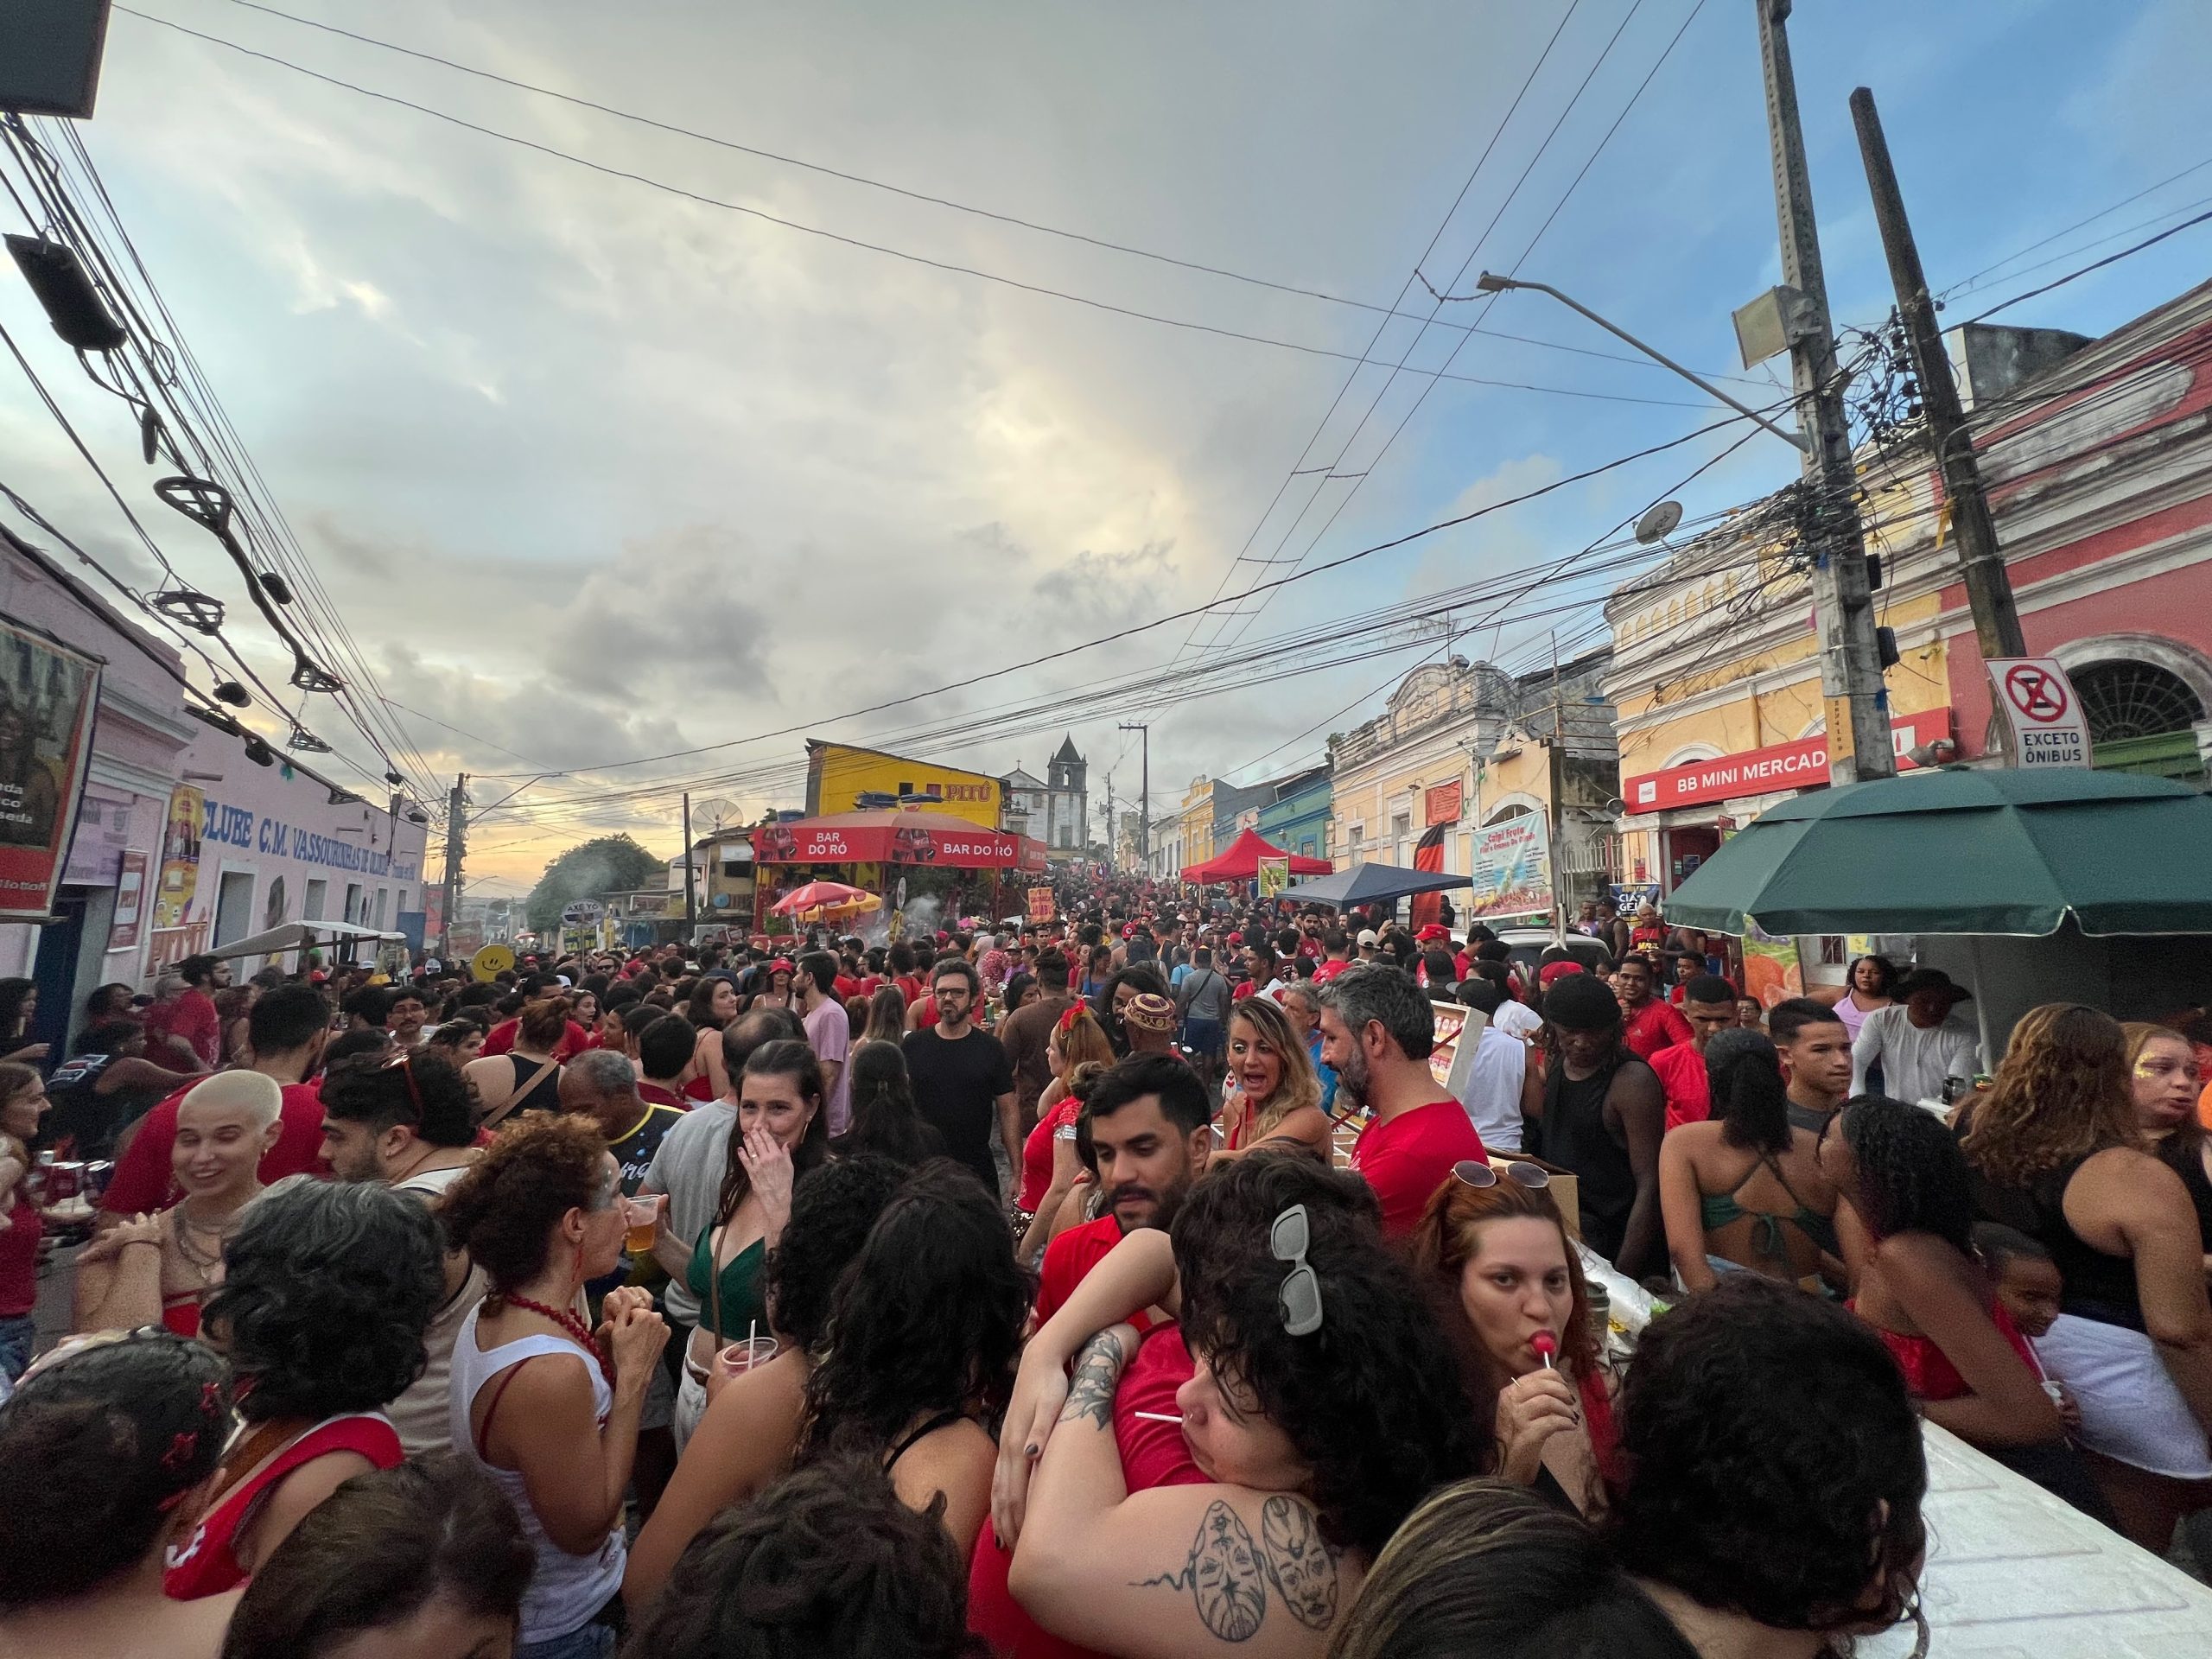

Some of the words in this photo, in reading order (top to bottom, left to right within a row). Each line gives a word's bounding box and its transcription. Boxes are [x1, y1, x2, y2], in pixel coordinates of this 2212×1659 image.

[2024, 733, 2080, 746] EXCETO
[2025, 747, 2082, 763] ÔNIBUS
[1677, 776, 1698, 792] BB
[1702, 767, 1738, 788] MINI
[1743, 750, 1827, 781] MERCAD
[259, 817, 288, 856] C.M.
[817, 832, 840, 842] BAR
[808, 845, 826, 855] DO
[830, 842, 848, 855] RÓ
[944, 843, 969, 855] BAR
[973, 845, 992, 855] DO
[995, 844, 1013, 856] RÓ
[1618, 893, 1637, 902] CIA
[1619, 902, 1637, 912] GEL
